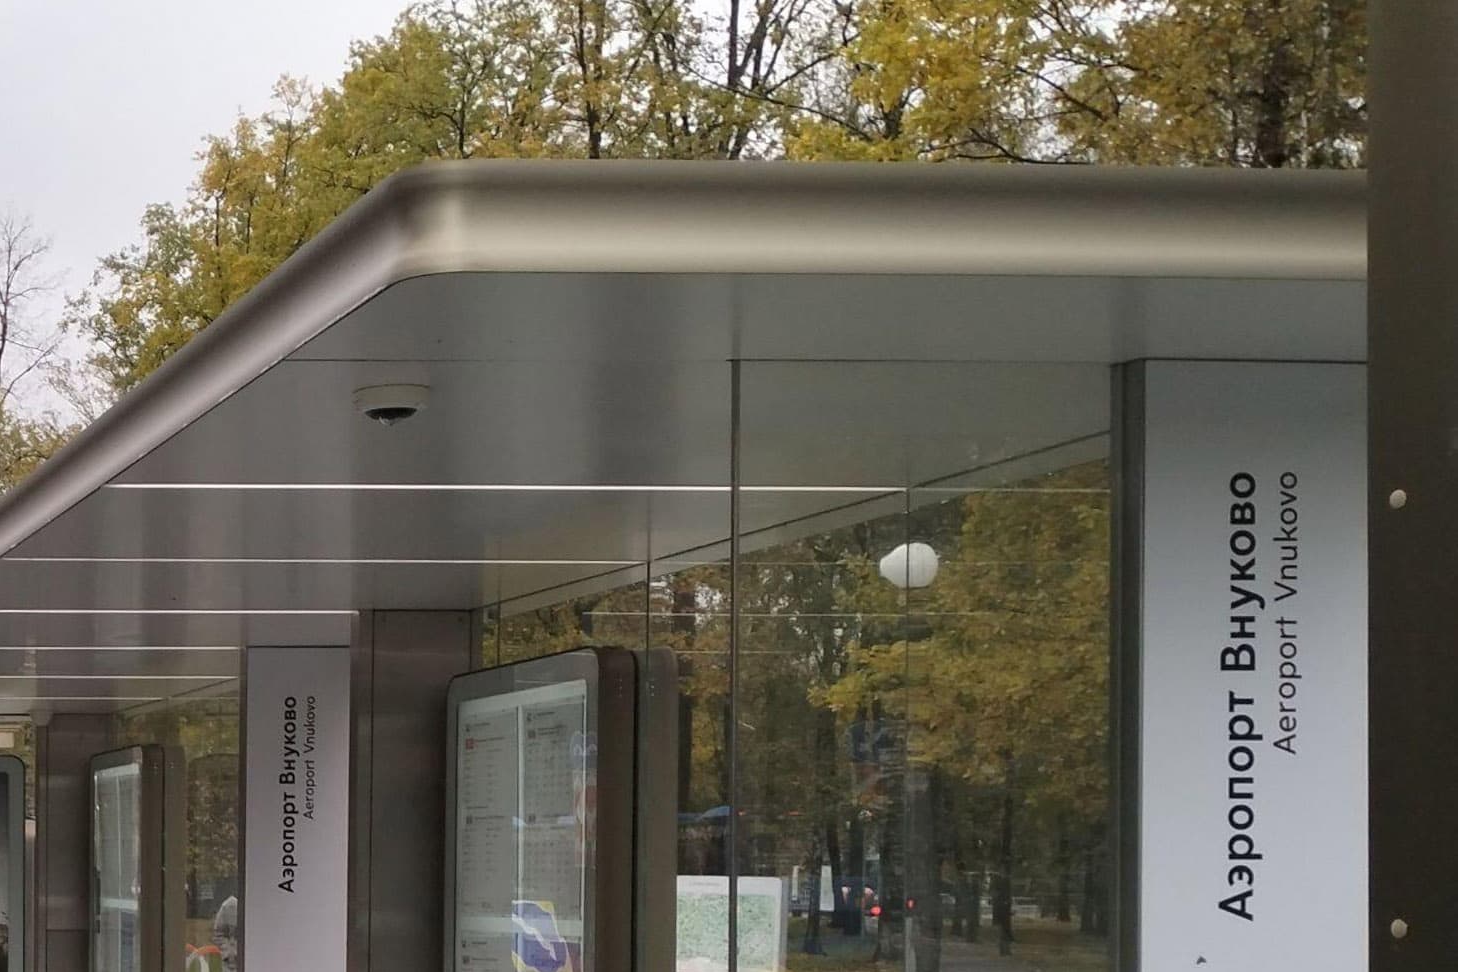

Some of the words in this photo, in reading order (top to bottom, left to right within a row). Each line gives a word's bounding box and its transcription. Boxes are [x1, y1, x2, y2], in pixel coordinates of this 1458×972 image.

[1219, 470, 1266, 673] Внуково
[1272, 470, 1299, 602] Vnukovo
[278, 695, 301, 786] Внуково
[303, 695, 316, 754] Vnukovo
[1272, 616, 1303, 755] Aeroport
[277, 791, 299, 893] Аэропорт
[303, 759, 318, 820] Aeroport
[1217, 690, 1264, 922] Аэропорт
